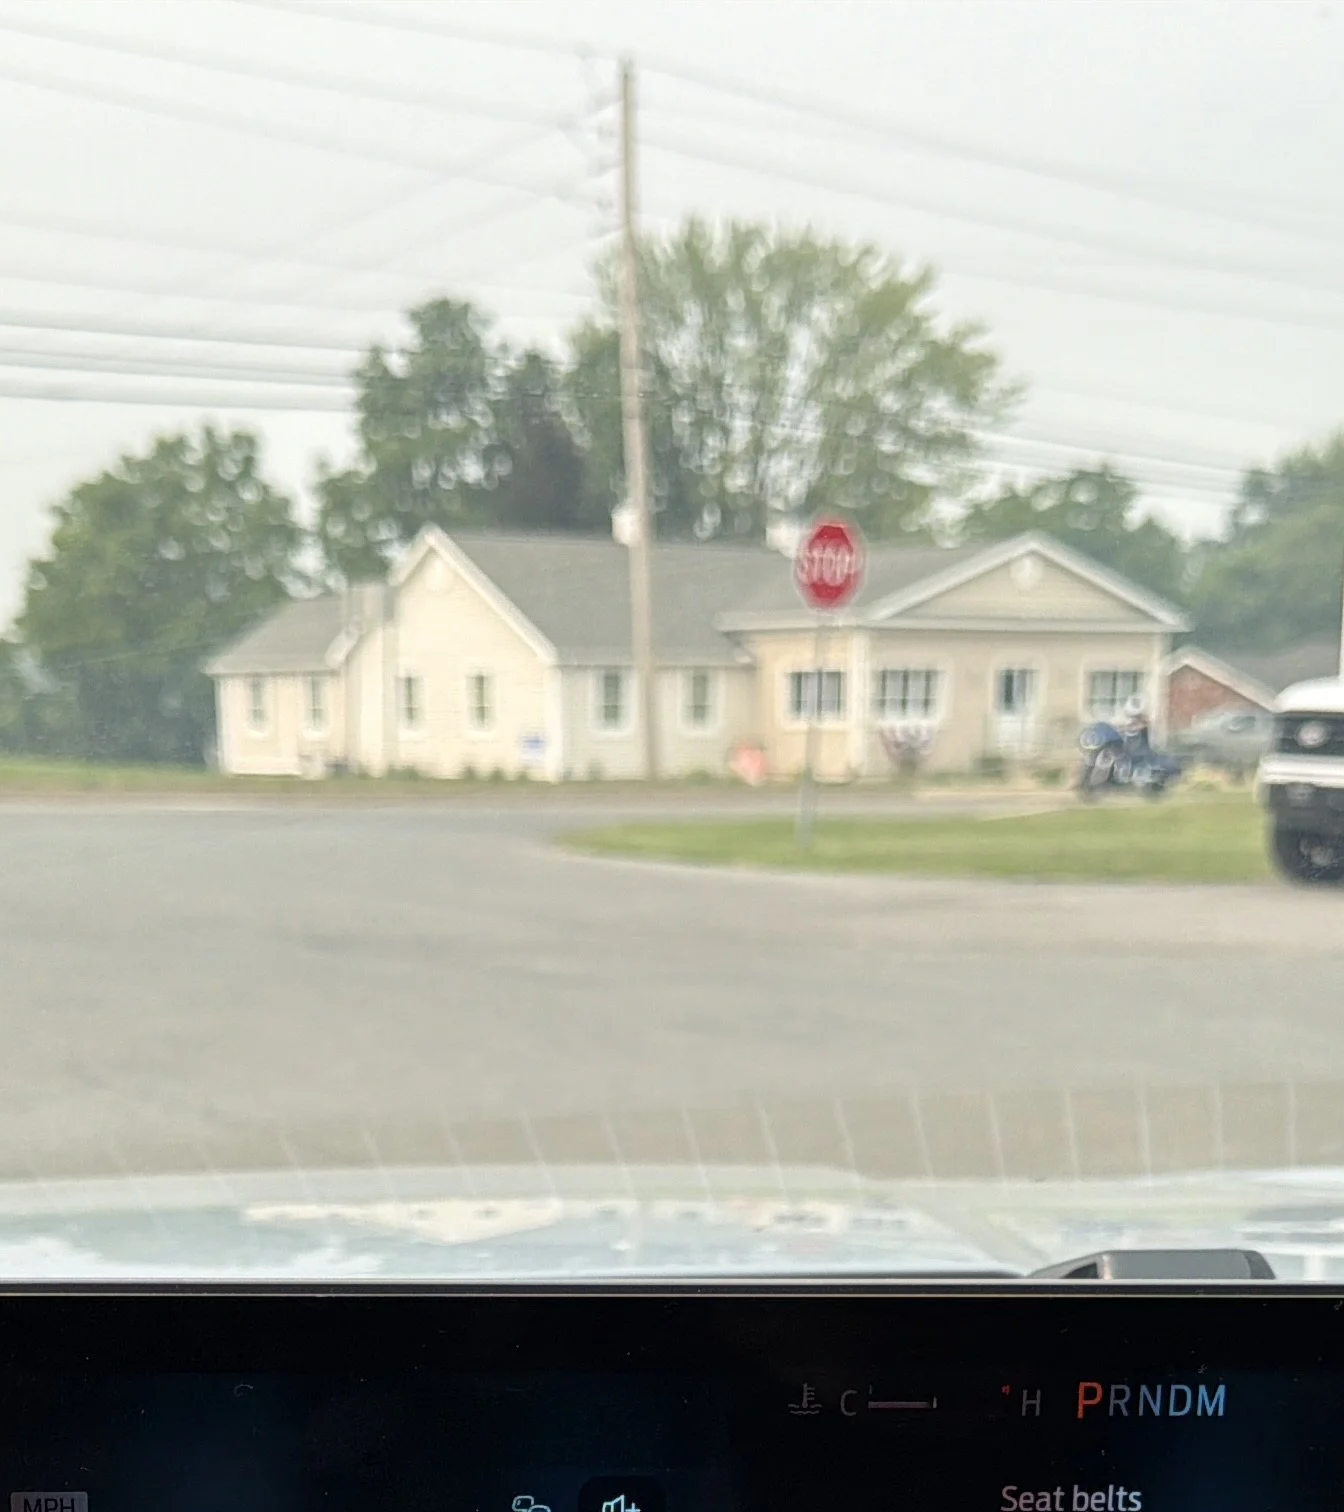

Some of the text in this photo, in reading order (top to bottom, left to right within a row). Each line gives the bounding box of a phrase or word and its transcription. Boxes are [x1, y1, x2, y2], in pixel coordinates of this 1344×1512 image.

[796, 545, 857, 586] STOP
[839, 1389, 859, 1417] C
[1020, 1389, 1042, 1417] H
[999, 1484, 1143, 1512] Seat belts
